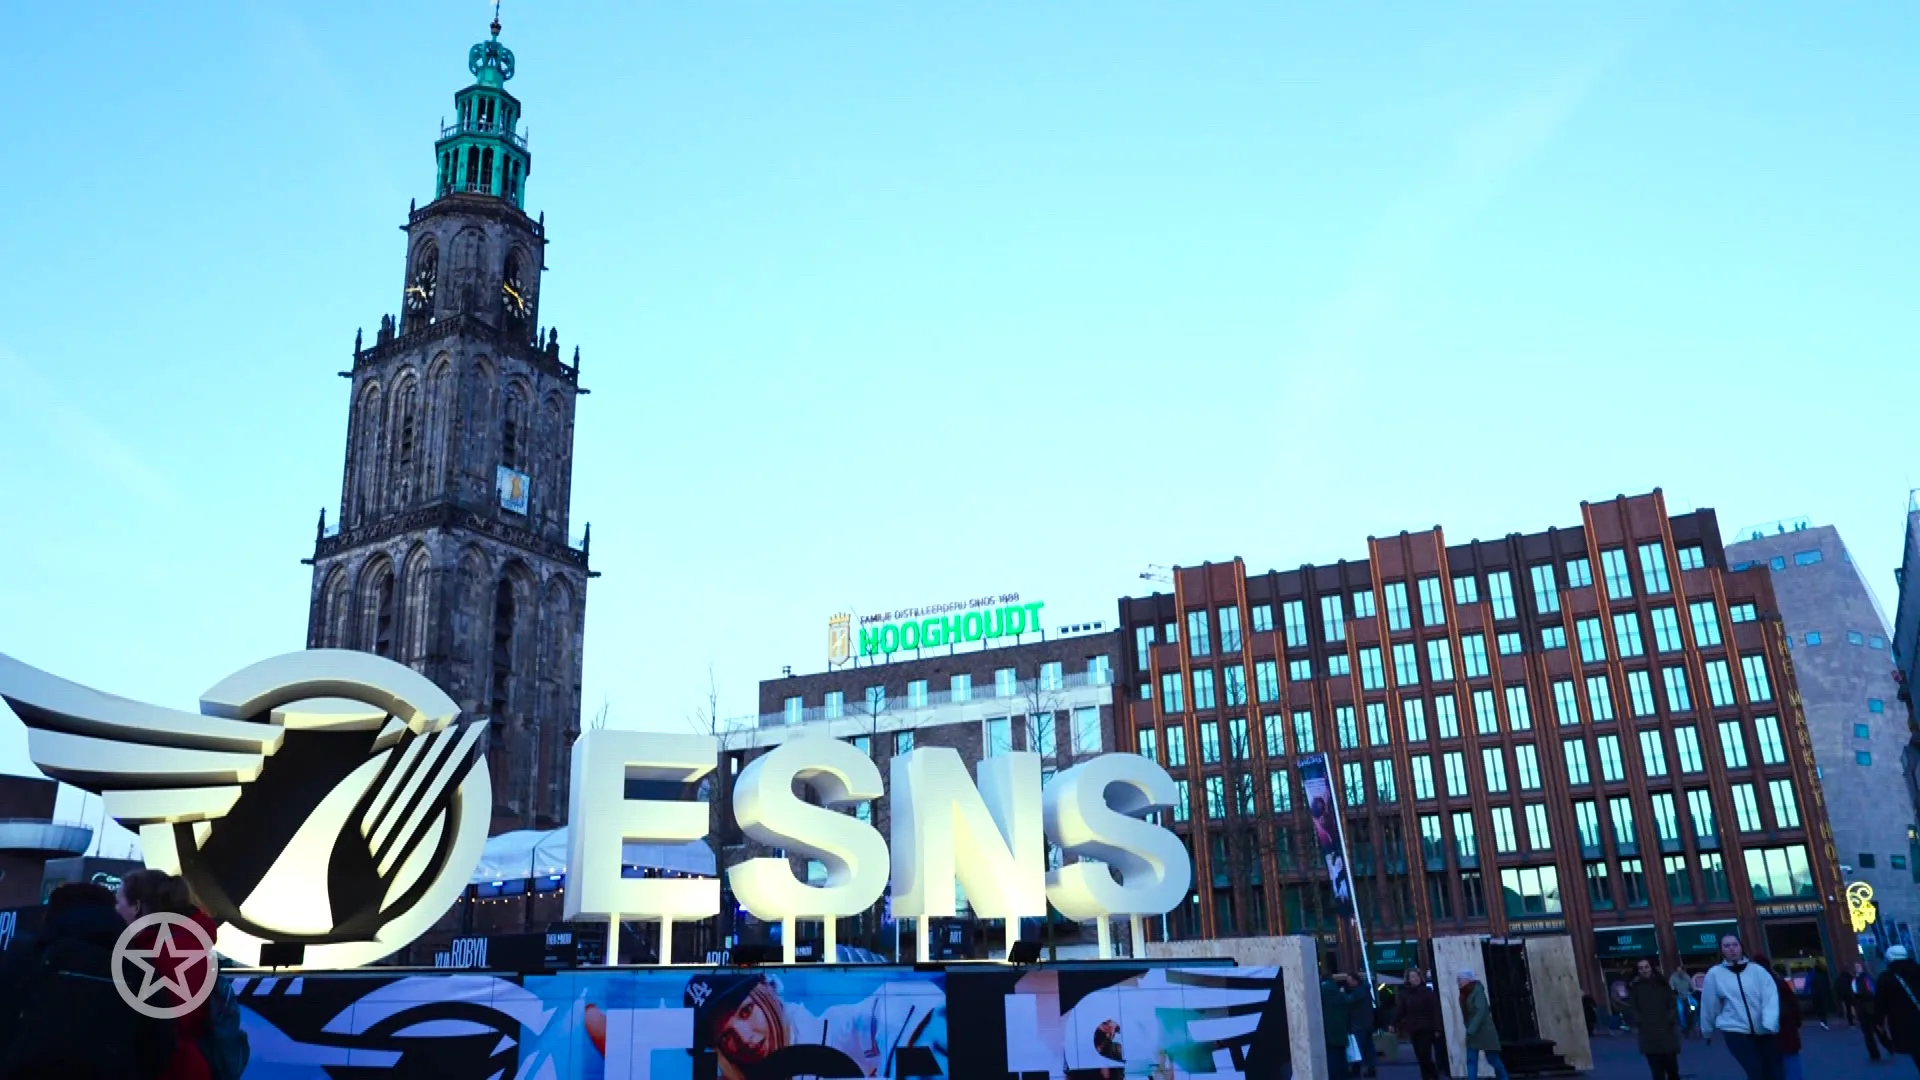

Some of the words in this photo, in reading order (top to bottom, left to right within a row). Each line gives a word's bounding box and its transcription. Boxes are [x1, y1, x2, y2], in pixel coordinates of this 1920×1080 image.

[859, 600, 1044, 657] HOOGHOUDT
[562, 730, 1191, 921] ESNS
[451, 937, 488, 968] ROBYN
